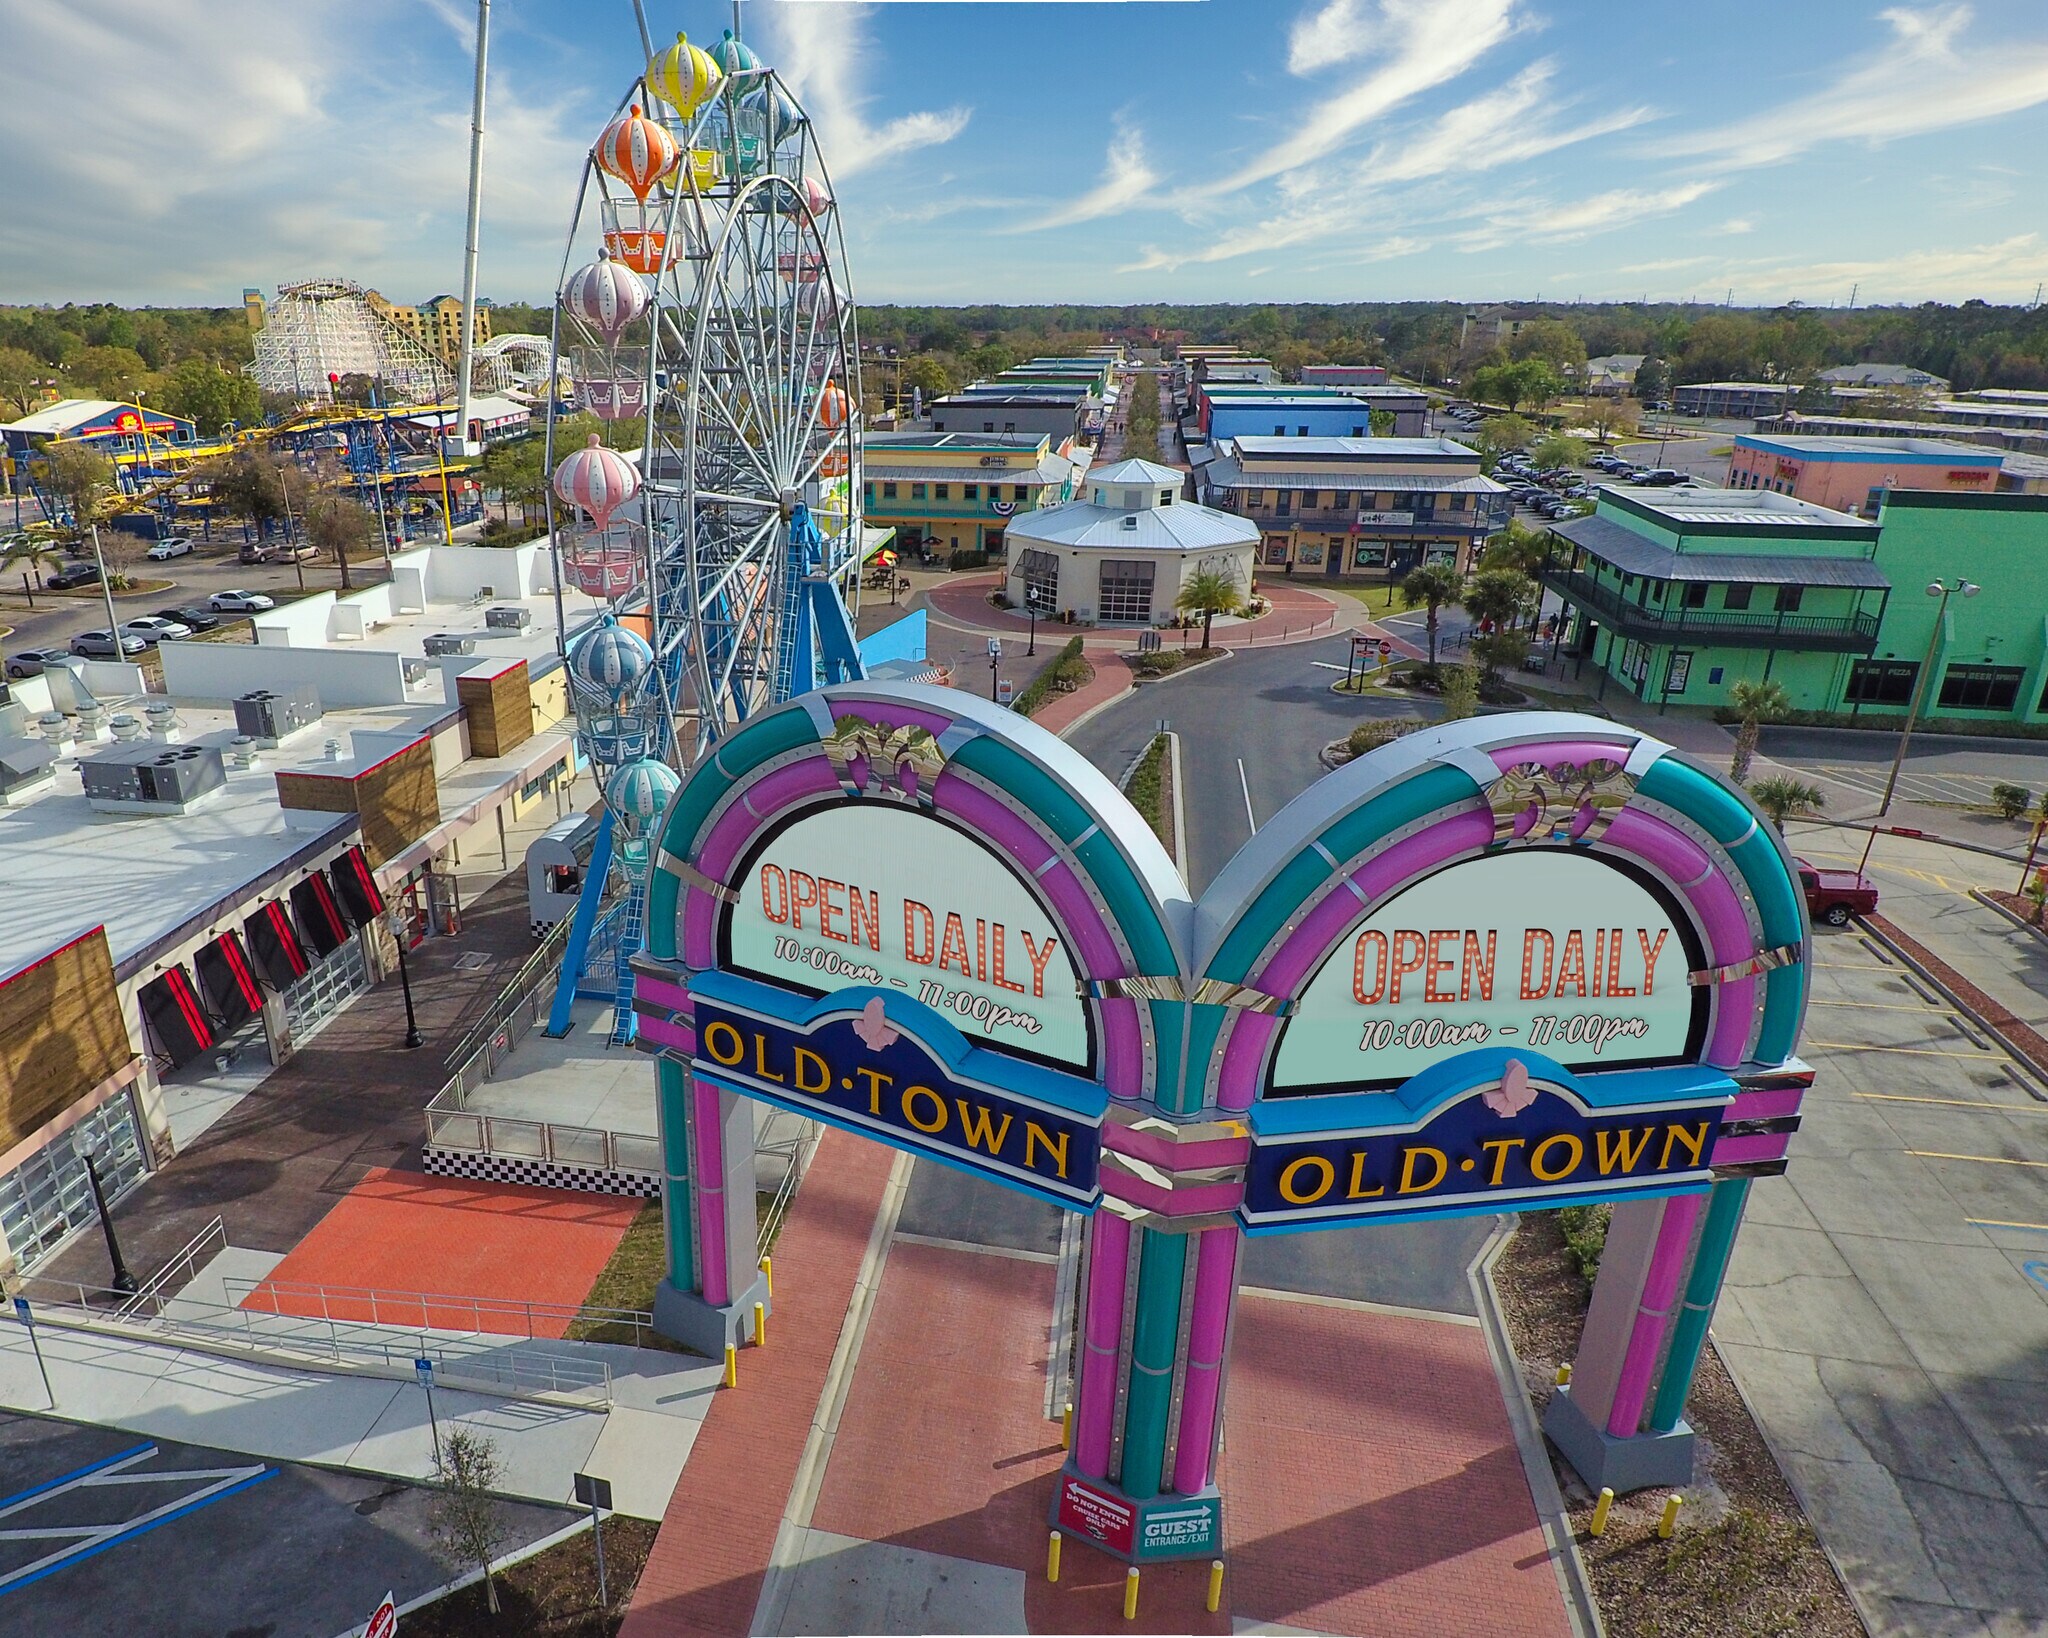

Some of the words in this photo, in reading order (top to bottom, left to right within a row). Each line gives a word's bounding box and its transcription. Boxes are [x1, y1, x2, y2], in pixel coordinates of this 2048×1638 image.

[1888, 668, 1912, 676] PIZZA
[760, 863, 880, 952] OPEN
[904, 898, 1058, 999] DAILY
[1353, 929, 1497, 1004] OPEN
[1520, 928, 1669, 1000] DAILY
[774, 935, 883, 985] 10:00am
[918, 979, 1043, 1035] 11:00pm
[1359, 1018, 1492, 1051] 10:00am
[1528, 1014, 1649, 1055] 11:00pm
[1066, 1493, 1079, 1502] DO
[1080, 1499, 1099, 1511] NOT
[1099, 1508, 1129, 1526] ENTER
[1073, 1504, 1100, 1521] CRUISE
[1101, 1518, 1121, 1530] CARS
[1086, 1516, 1105, 1529] ONLY
[1144, 1532, 1209, 1547] ENTRANCE/EXIT
[1145, 1518, 1211, 1537] GUEST
[376, 1606, 388, 1628] NOT
